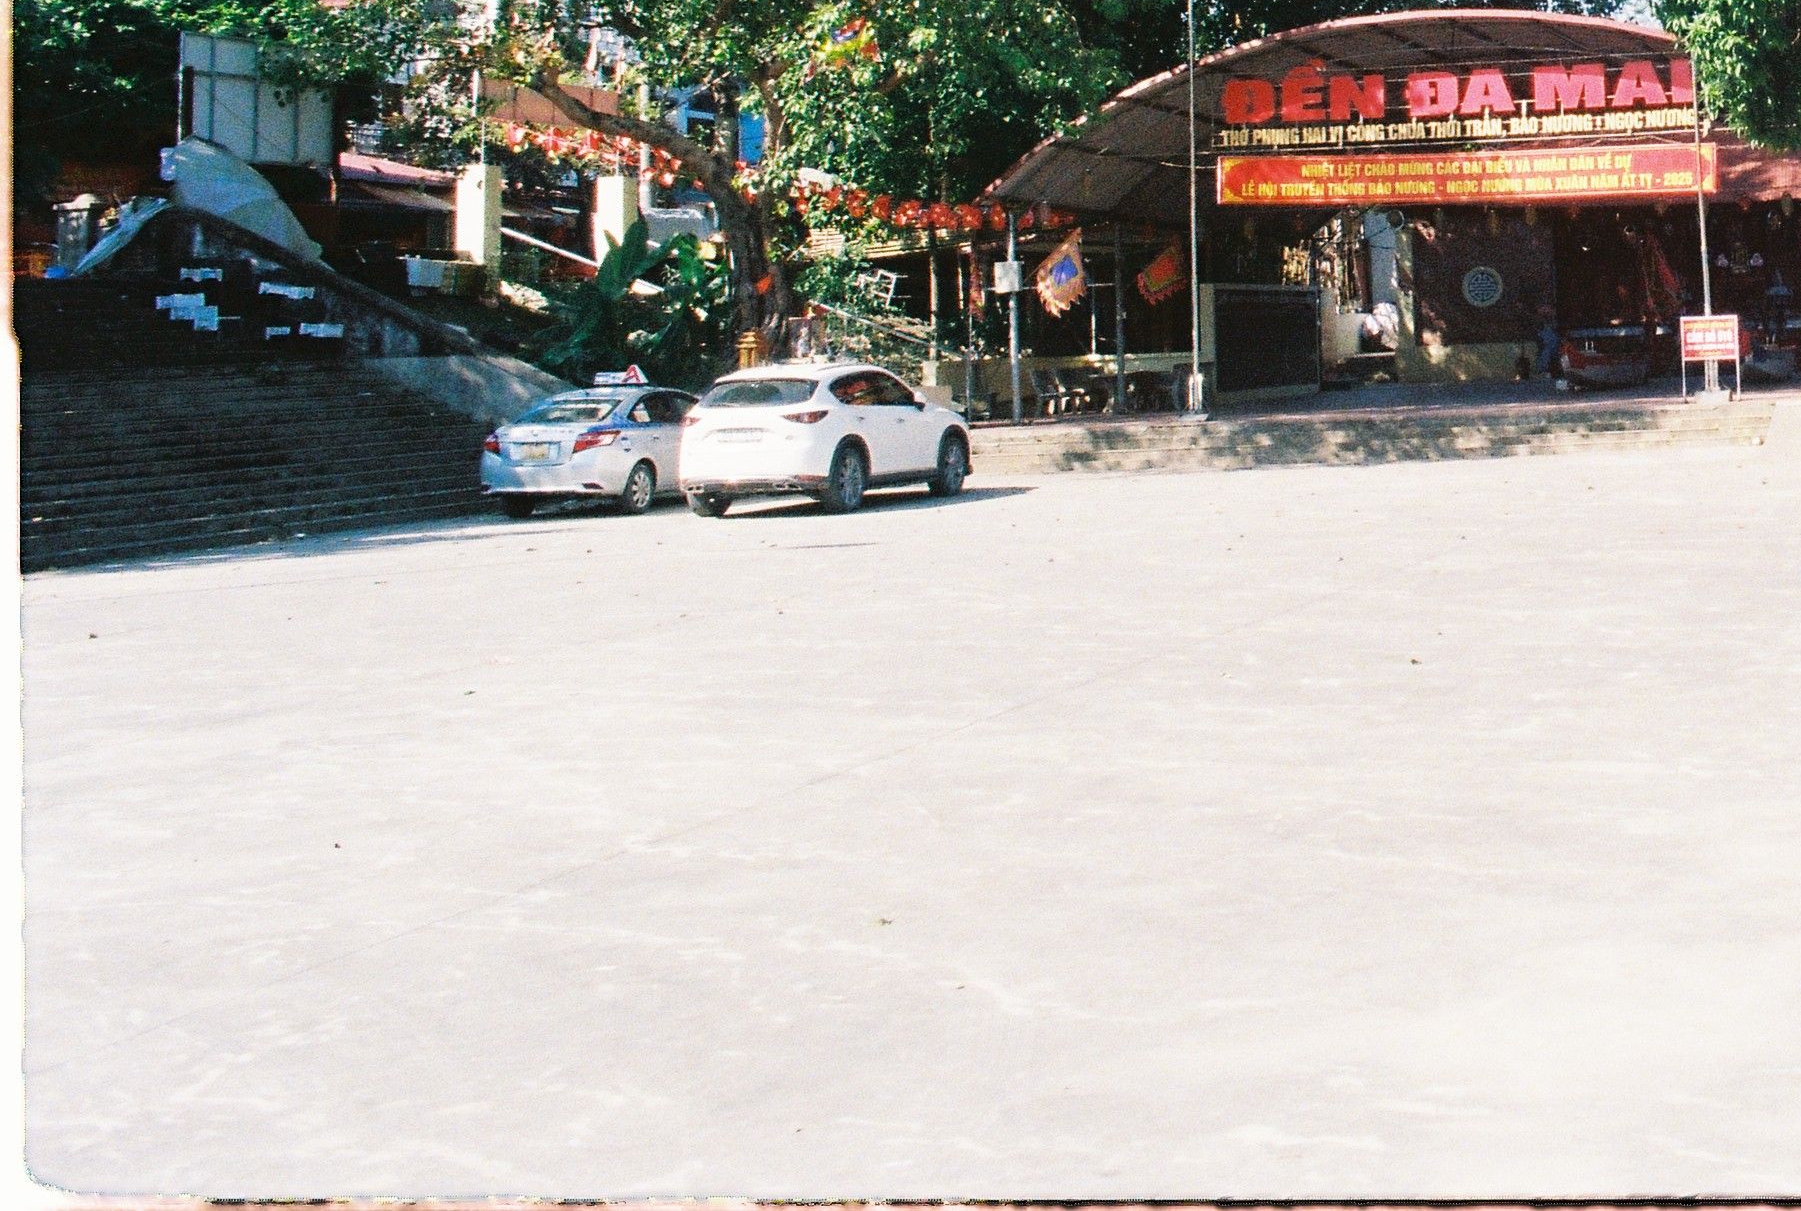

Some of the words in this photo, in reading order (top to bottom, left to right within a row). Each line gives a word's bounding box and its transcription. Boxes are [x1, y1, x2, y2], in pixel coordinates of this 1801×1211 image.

[1221, 57, 1386, 124] ĐỀN
[1404, 68, 1516, 118] ĐA
[1531, 57, 1694, 112] MAI
[1302, 126, 1327, 144] HAI
[1337, 161, 1362, 180] LIỆT
